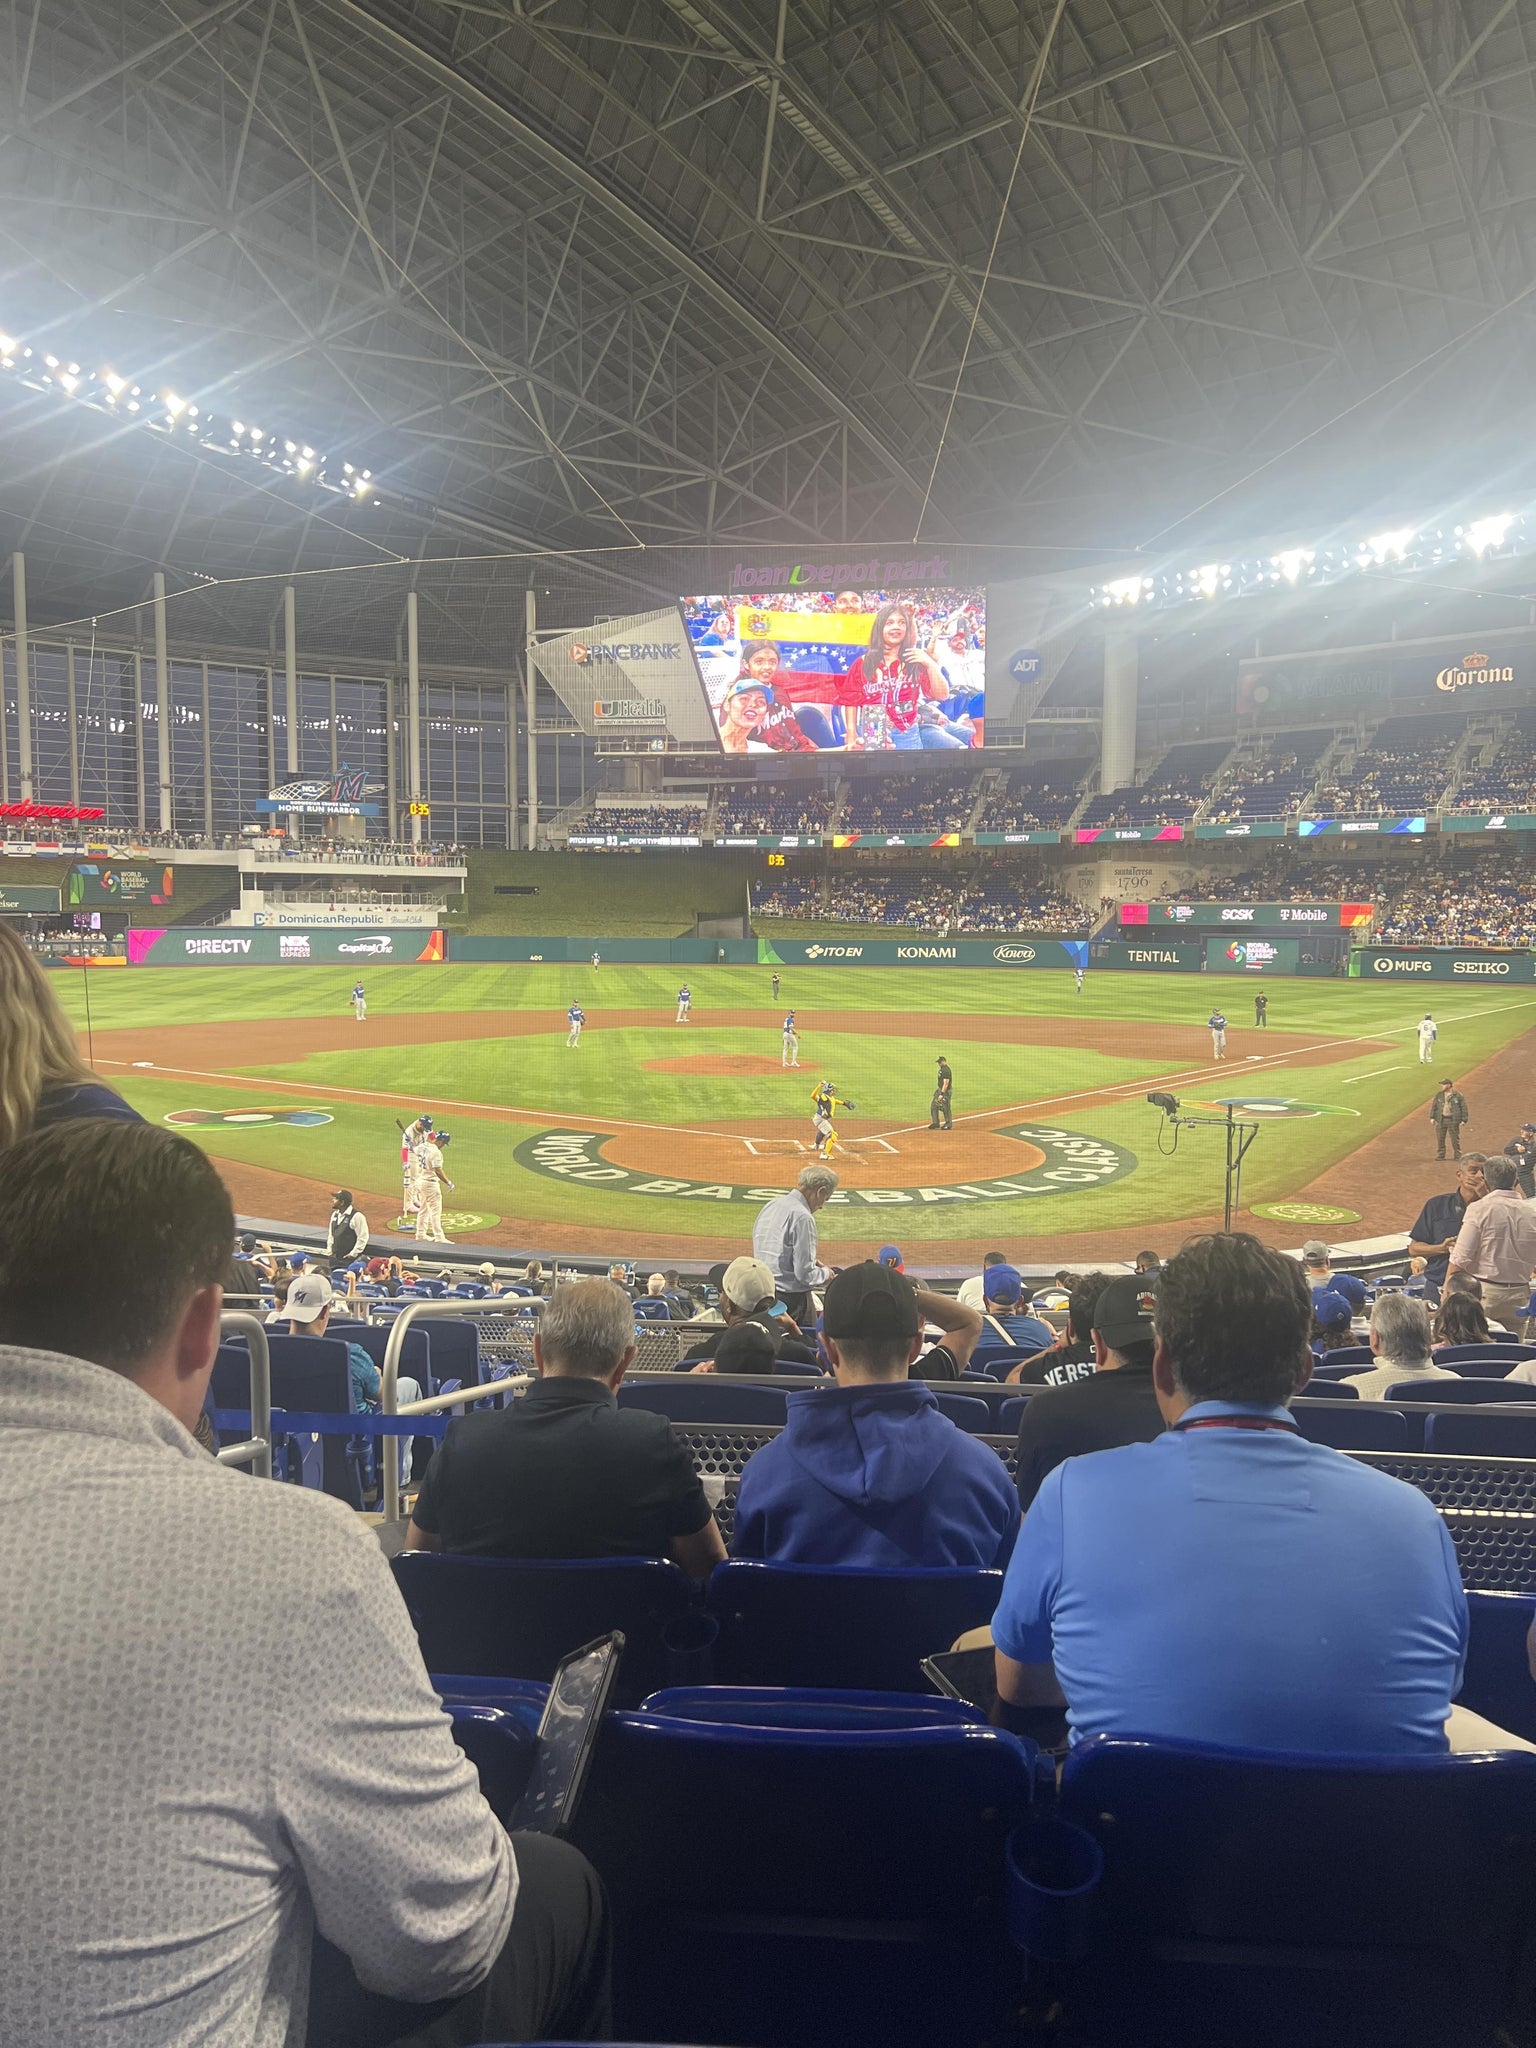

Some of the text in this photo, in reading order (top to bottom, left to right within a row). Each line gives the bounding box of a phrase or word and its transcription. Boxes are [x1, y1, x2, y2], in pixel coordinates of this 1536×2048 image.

[883, 556, 949, 586] park
[1013, 659, 1039, 671] ADT
[1298, 670, 1386, 698] MIAMI
[1436, 666, 1514, 692] Corona
[651, 740, 664, 749] 42
[410, 803, 430, 816] 0:35
[768, 854, 785, 866] 0:35
[1118, 876, 1148, 891] 1796
[1222, 909, 1255, 921] SCSK
[1291, 908, 1328, 921] Mobile
[186, 939, 252, 954] DIRECTV
[998, 947, 1034, 958] Kowa
[897, 948, 956, 958] KONAMI
[1128, 951, 1180, 963] TENTIAL
[1394, 960, 1432, 972] MUFG
[1453, 962, 1510, 974] SEIKO
[531, 1135, 630, 1180] WORLD
[1019, 1129, 1120, 1182] CLASSIC
